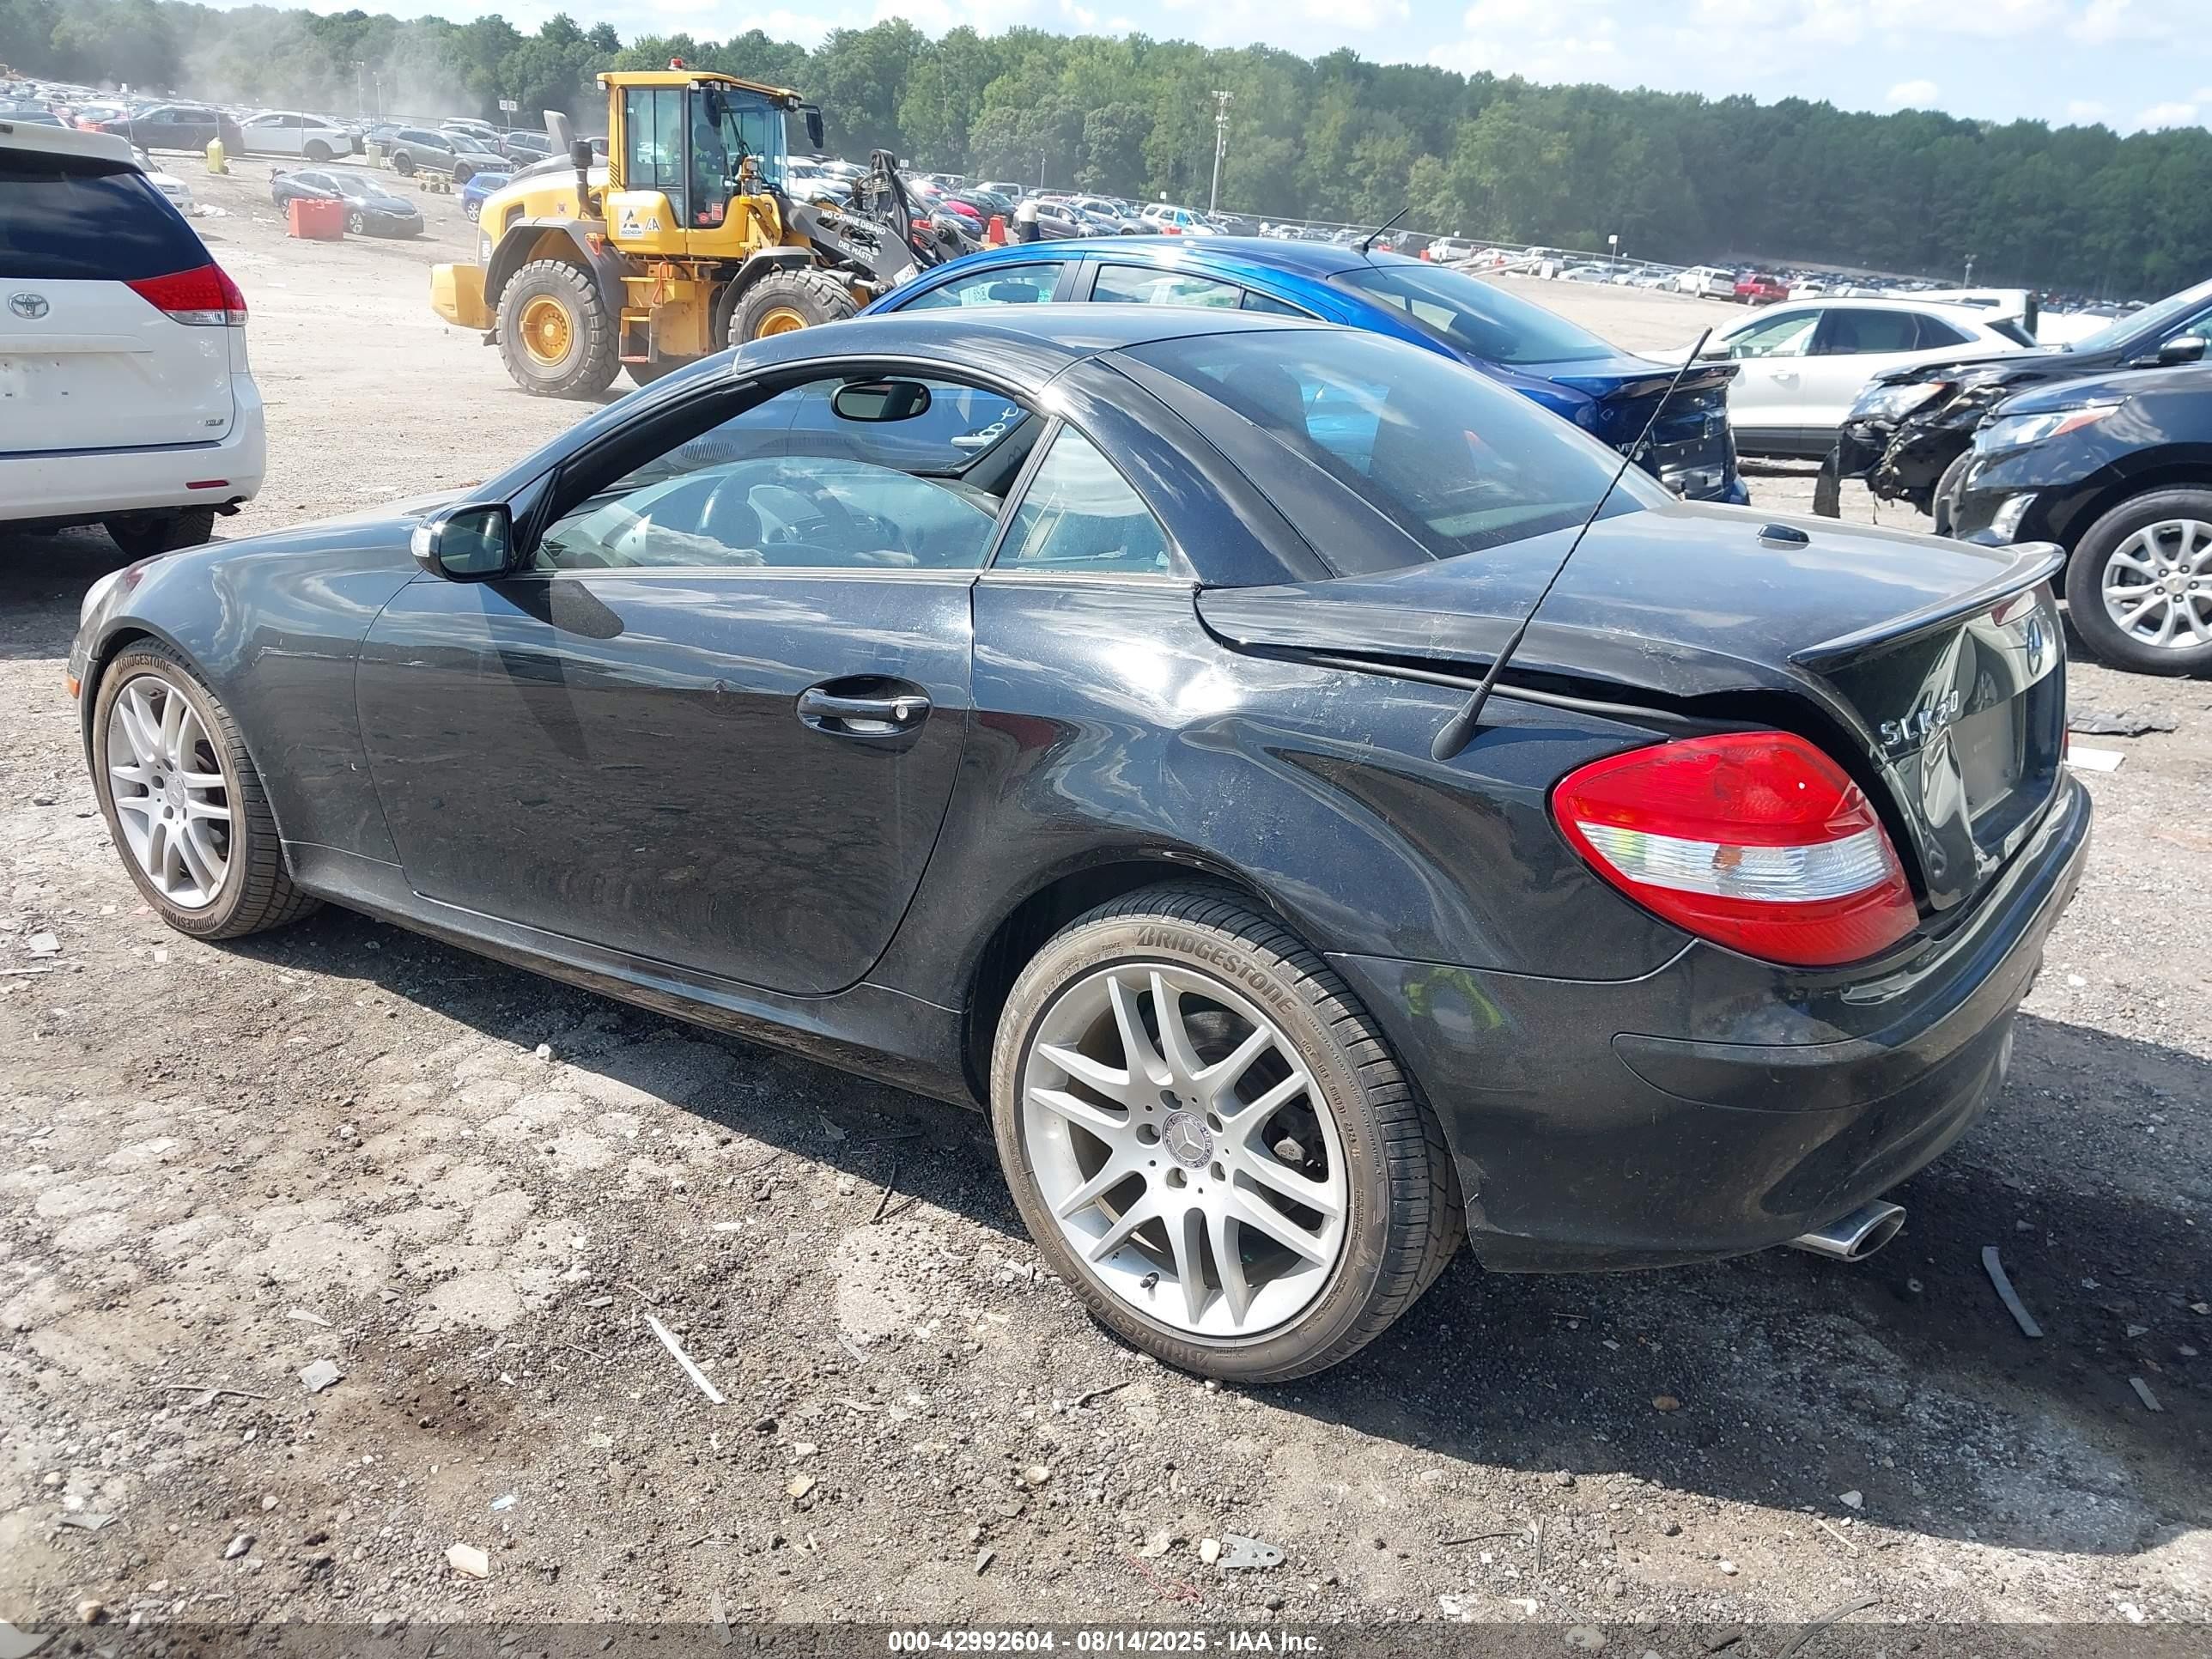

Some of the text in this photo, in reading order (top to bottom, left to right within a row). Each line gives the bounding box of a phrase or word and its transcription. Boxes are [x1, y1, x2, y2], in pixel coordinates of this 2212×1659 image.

[821, 210, 886, 235] NO CAMINE DEBAJO
[837, 240, 851, 252] DEL
[116, 653, 173, 676] BRIDGESTONE
[161, 904, 217, 930] BRIDGESTONE
[1136, 925, 1298, 1015] BRIDGESTONE
[1066, 1269, 1211, 1367] BRIDGESTONE
